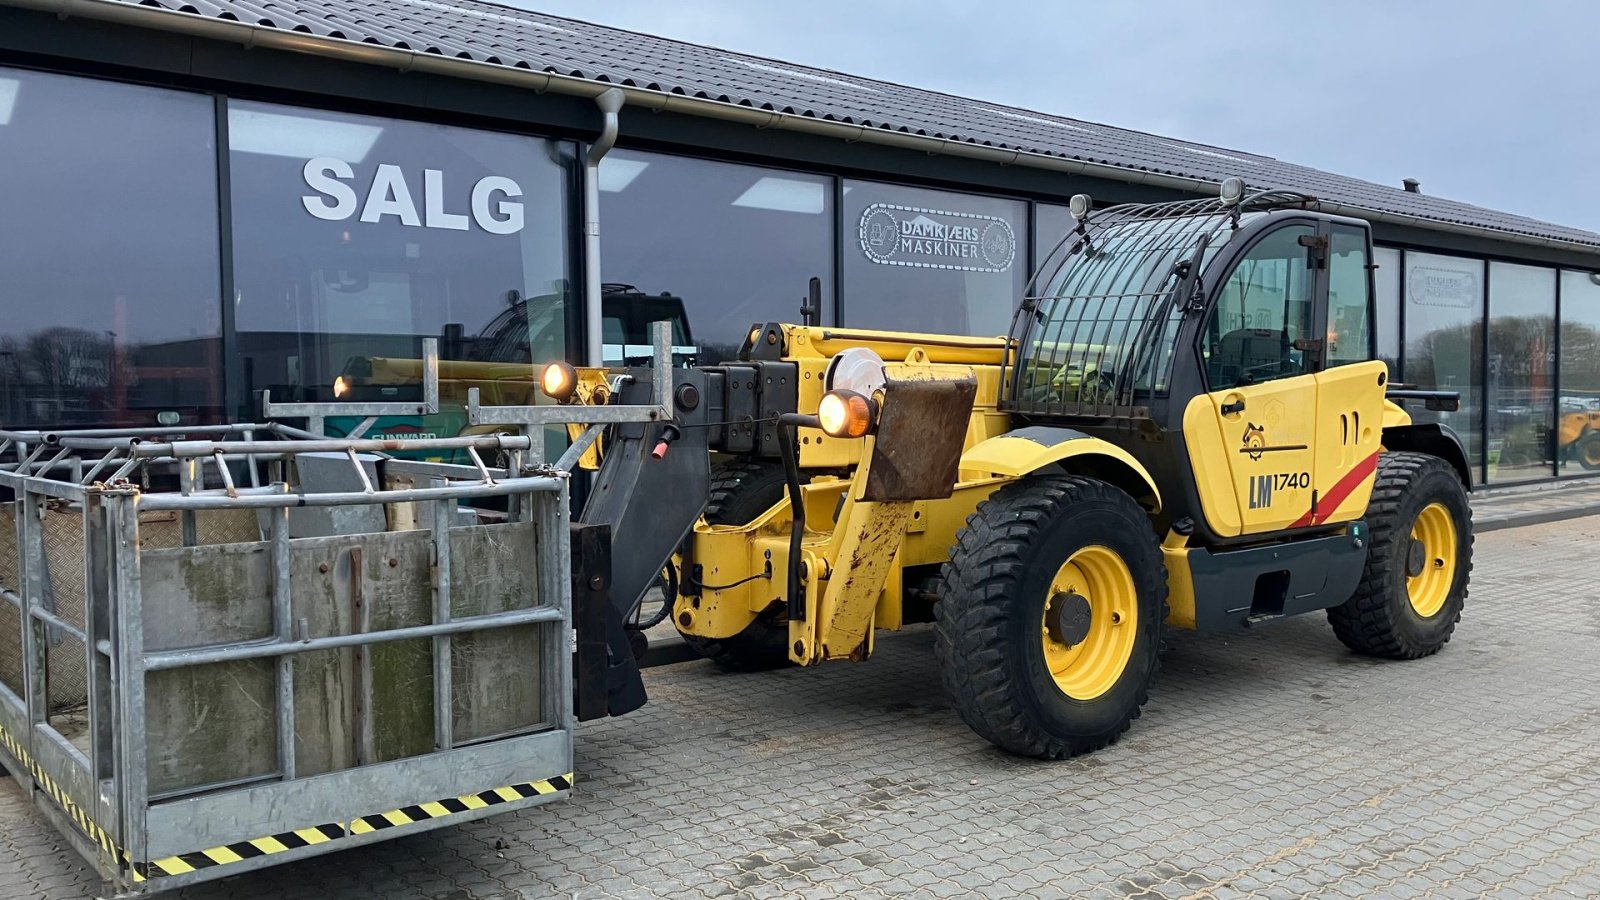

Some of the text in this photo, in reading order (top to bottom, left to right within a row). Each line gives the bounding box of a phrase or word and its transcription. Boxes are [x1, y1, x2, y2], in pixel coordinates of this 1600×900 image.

[302, 157, 524, 235] SALG
[902, 220, 979, 242] DAMKJÆRS
[901, 238, 978, 258] MASKINER
